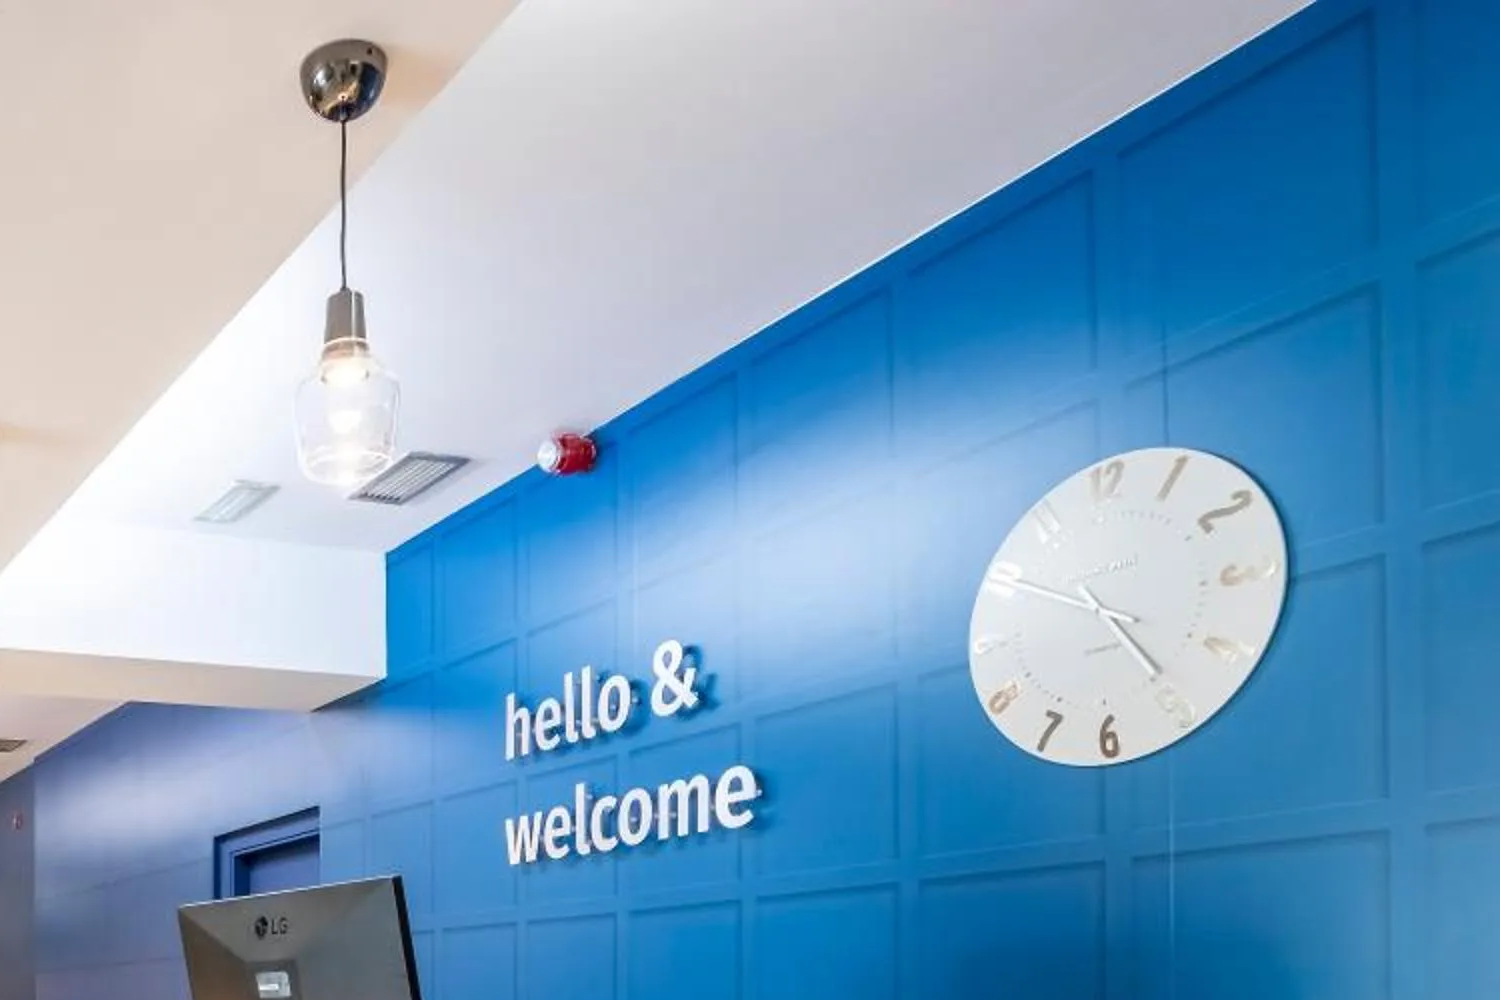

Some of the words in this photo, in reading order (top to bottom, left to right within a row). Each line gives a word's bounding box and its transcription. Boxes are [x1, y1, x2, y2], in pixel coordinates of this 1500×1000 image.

[1088, 459, 1125, 501] 12
[1156, 455, 1189, 502] 1
[1197, 489, 1254, 534] 2
[505, 664, 631, 762] hello
[651, 639, 699, 717] &
[1036, 708, 1064, 753] 7
[1099, 713, 1121, 759] 6
[504, 764, 757, 866] welcome
[271, 917, 289, 935] LG
